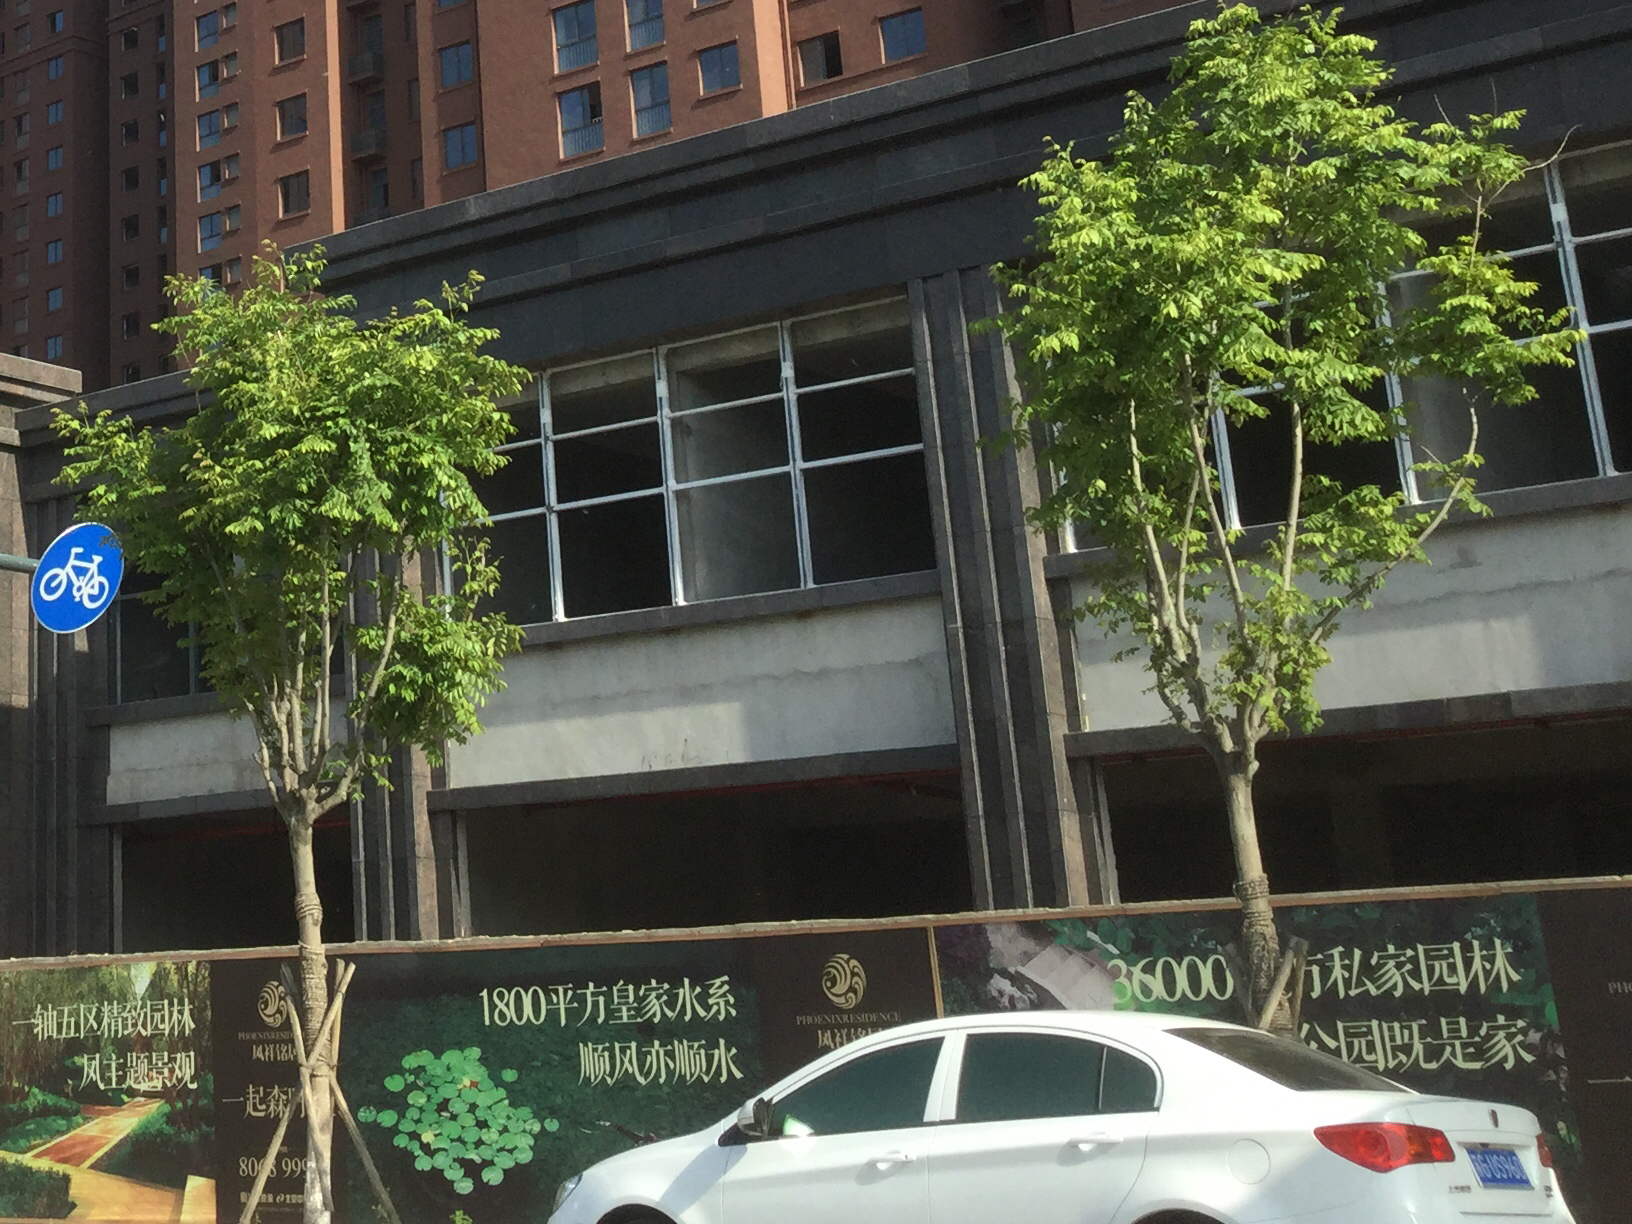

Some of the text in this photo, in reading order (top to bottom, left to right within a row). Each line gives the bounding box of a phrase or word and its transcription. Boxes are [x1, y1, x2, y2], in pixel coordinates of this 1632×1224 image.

[12, 998, 196, 1042] 一轴五区精致园林
[478, 975, 737, 1028] 1800平方皇家水系
[578, 1038, 744, 1087] 顺风亦顺水
